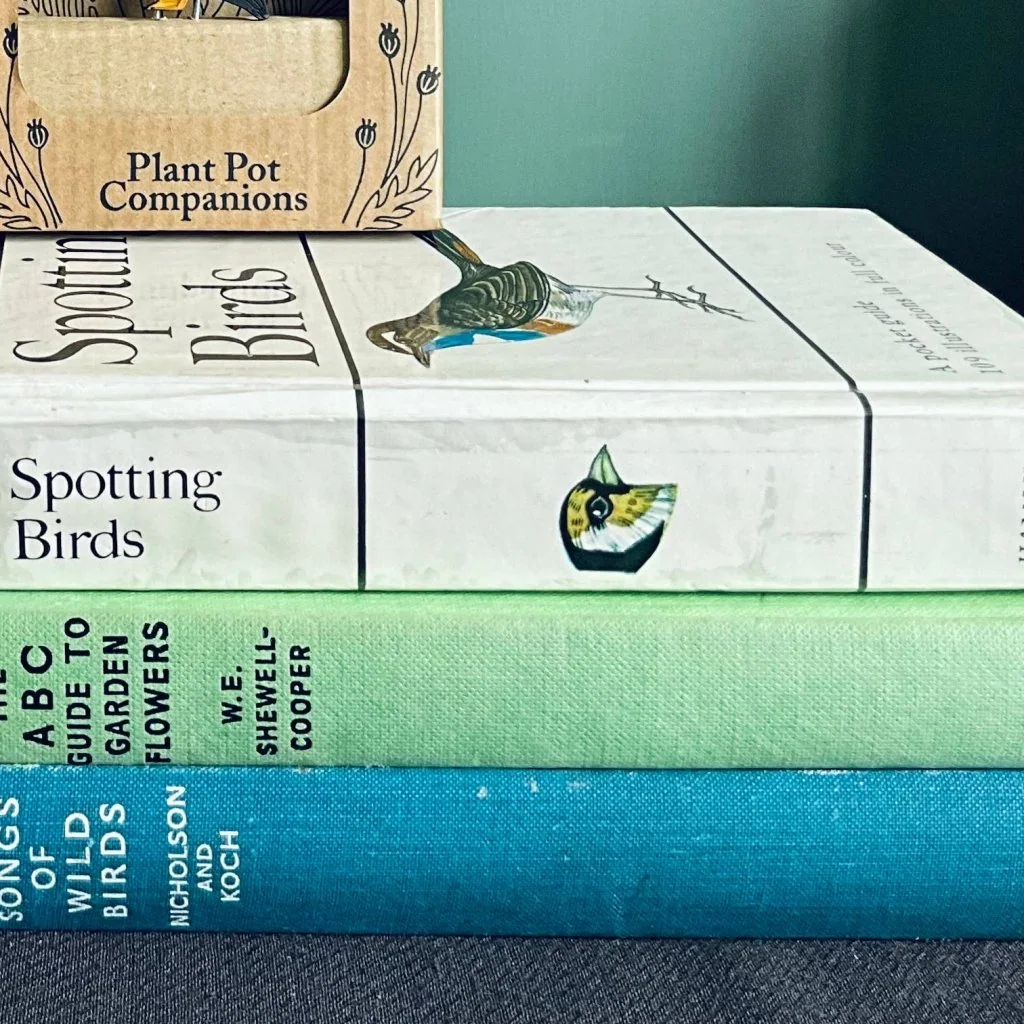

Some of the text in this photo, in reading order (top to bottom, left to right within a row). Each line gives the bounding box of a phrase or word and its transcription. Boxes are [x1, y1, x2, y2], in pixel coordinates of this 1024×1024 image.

[100, 180, 308, 222] Companions
[127, 152, 280, 182] Plant Pot
[825, 241, 866, 268] colour
[850, 269, 890, 284] full
[882, 286, 903, 296] in
[12, 236, 173, 365] Spottin
[181, 267, 320, 367] Birds
[852, 299, 958, 374] A pocket guide
[895, 297, 979, 354] illustrations
[10, 456, 223, 513] Spotting
[13, 518, 145, 561] Birds
[64, 616, 93, 765] GUIDE TO
[102, 635, 131, 756] GARDEN
[142, 621, 172, 763] FLOWERS
[255, 626, 277, 756] SHEWELL-
[289, 645, 313, 752] COOPER
[29, 846, 56, 890] OF
[64, 812, 93, 914] WILD
[99, 803, 128, 918] BIRDS
[166, 785, 190, 927] NICHOLSON
[196, 842, 214, 893] AND
[219, 830, 241, 902] KOCH
